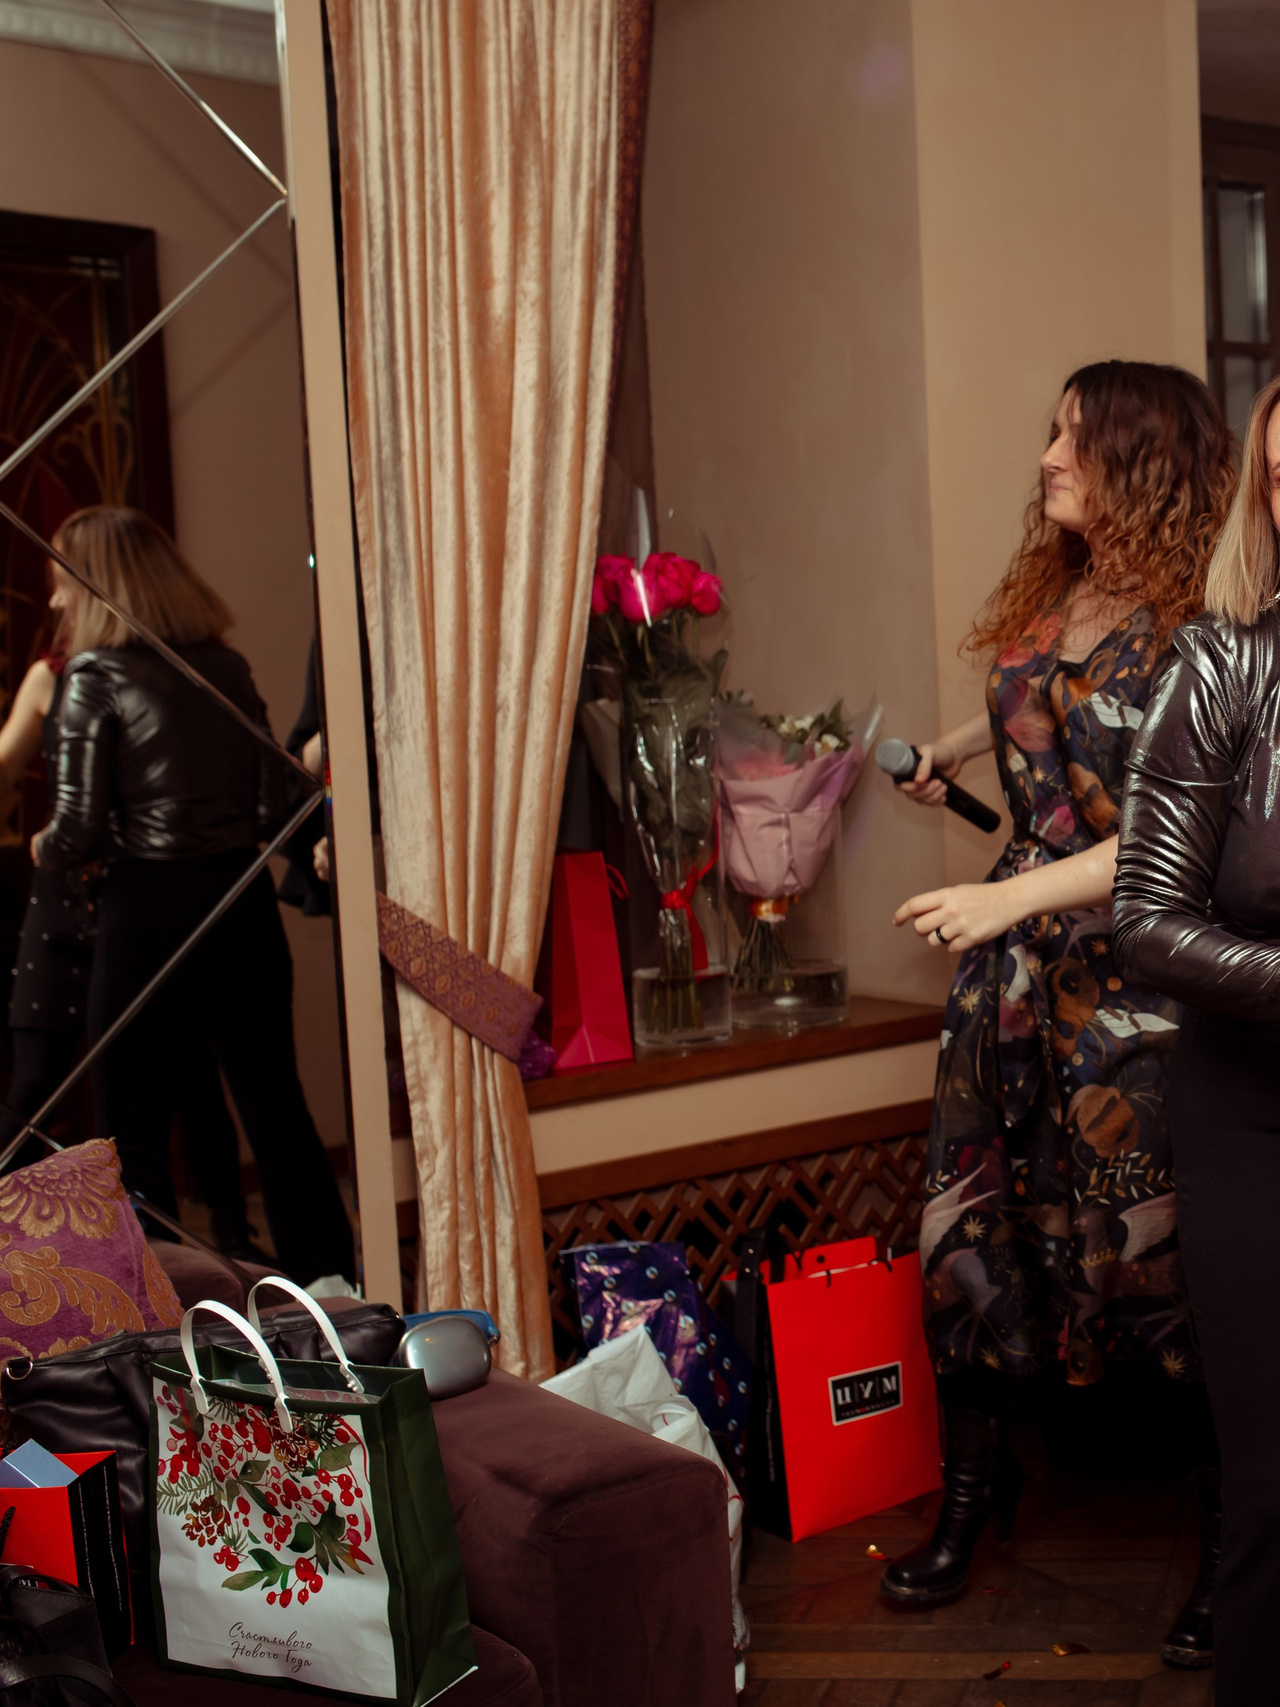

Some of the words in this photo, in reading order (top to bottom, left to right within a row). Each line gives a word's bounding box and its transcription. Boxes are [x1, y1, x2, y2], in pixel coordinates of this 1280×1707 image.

[228, 1621, 313, 1650] Счастливого
[231, 1641, 279, 1659] Нового
[286, 1649, 313, 1673] Года
